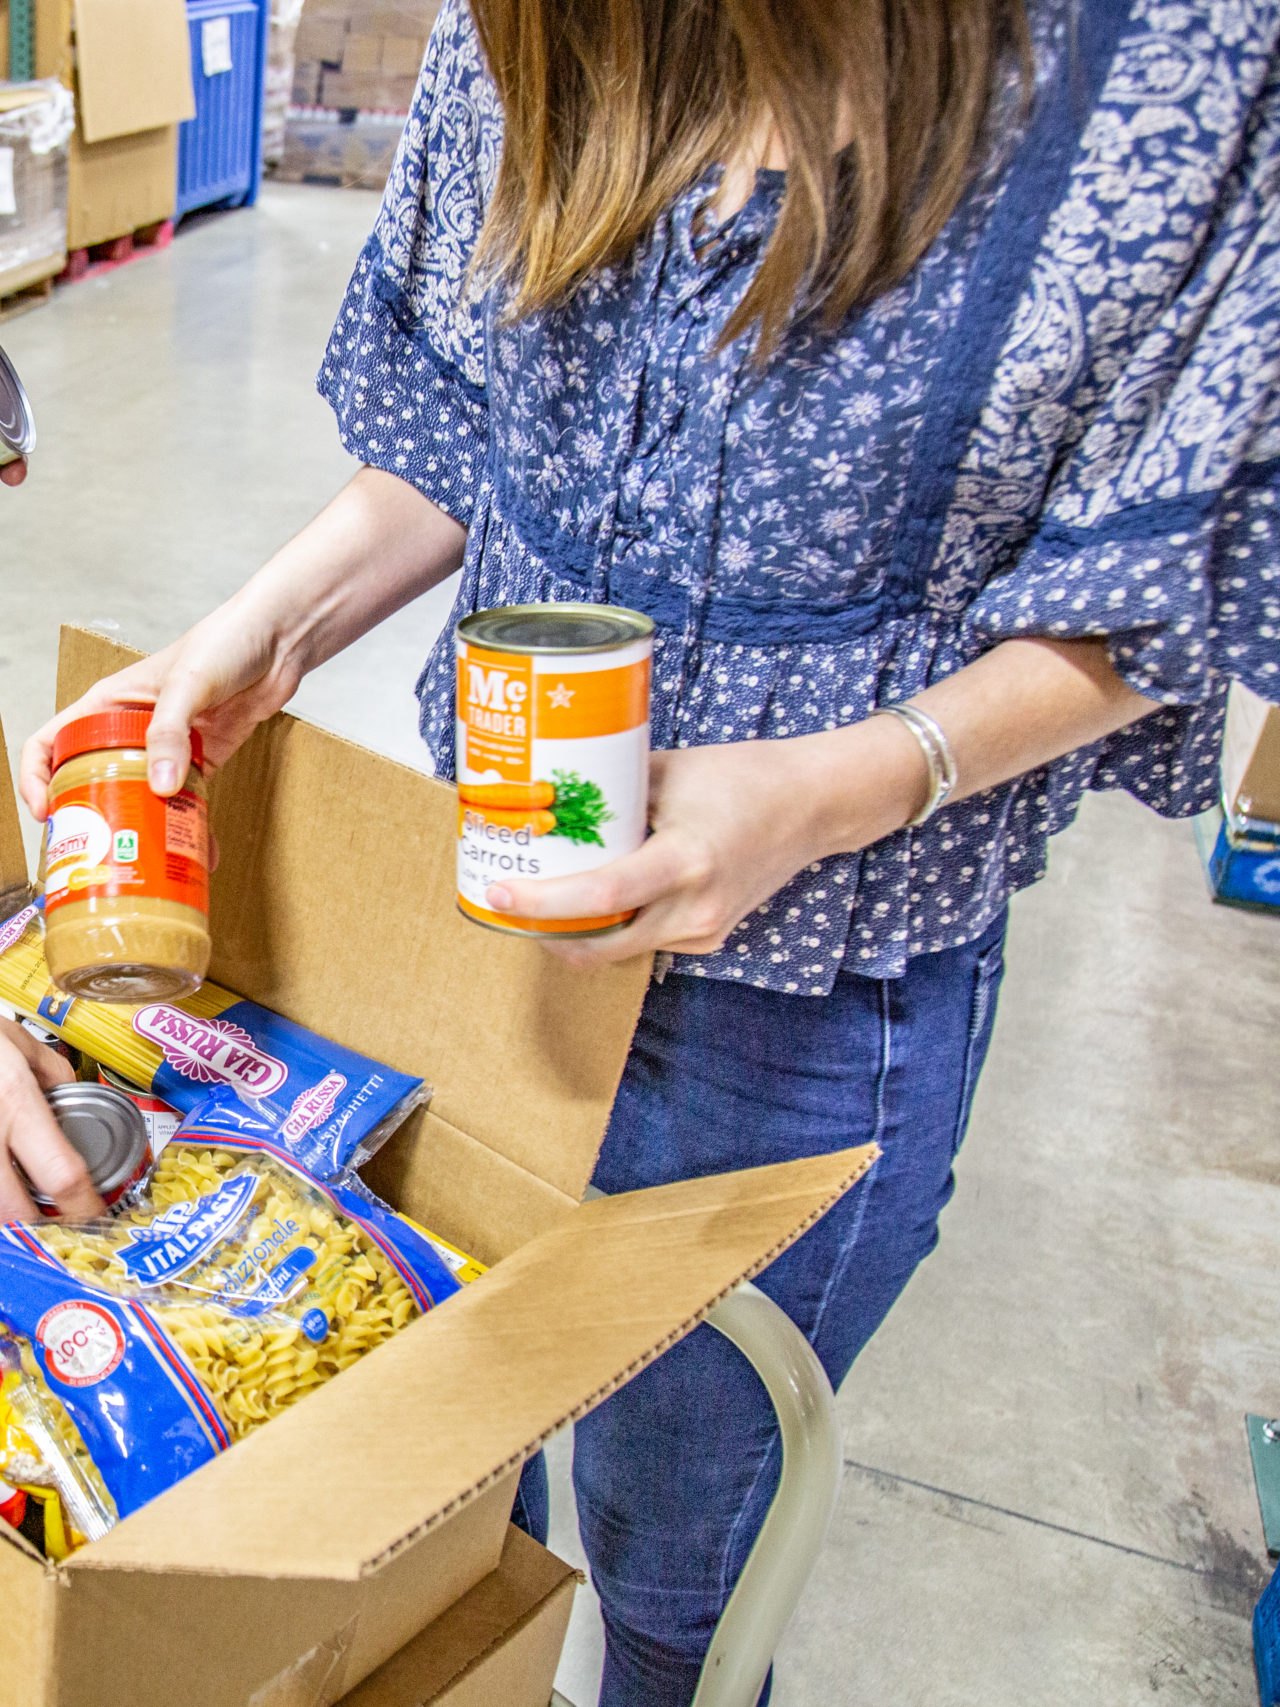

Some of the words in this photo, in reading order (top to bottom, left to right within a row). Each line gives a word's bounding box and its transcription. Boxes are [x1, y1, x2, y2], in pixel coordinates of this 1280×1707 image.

[467, 705, 527, 737] TRADER
[47, 834, 89, 858] reamy
[465, 808, 531, 847] Sliced
[462, 834, 541, 875] Carrots
[13, 907, 33, 925] GIA
[149, 1008, 229, 1062] RUSSA
[223, 1046, 273, 1086] GIA
[285, 1113, 312, 1136] GIA
[303, 1079, 342, 1115] RUSSA
[320, 1074, 385, 1142] SPAGHETTI
